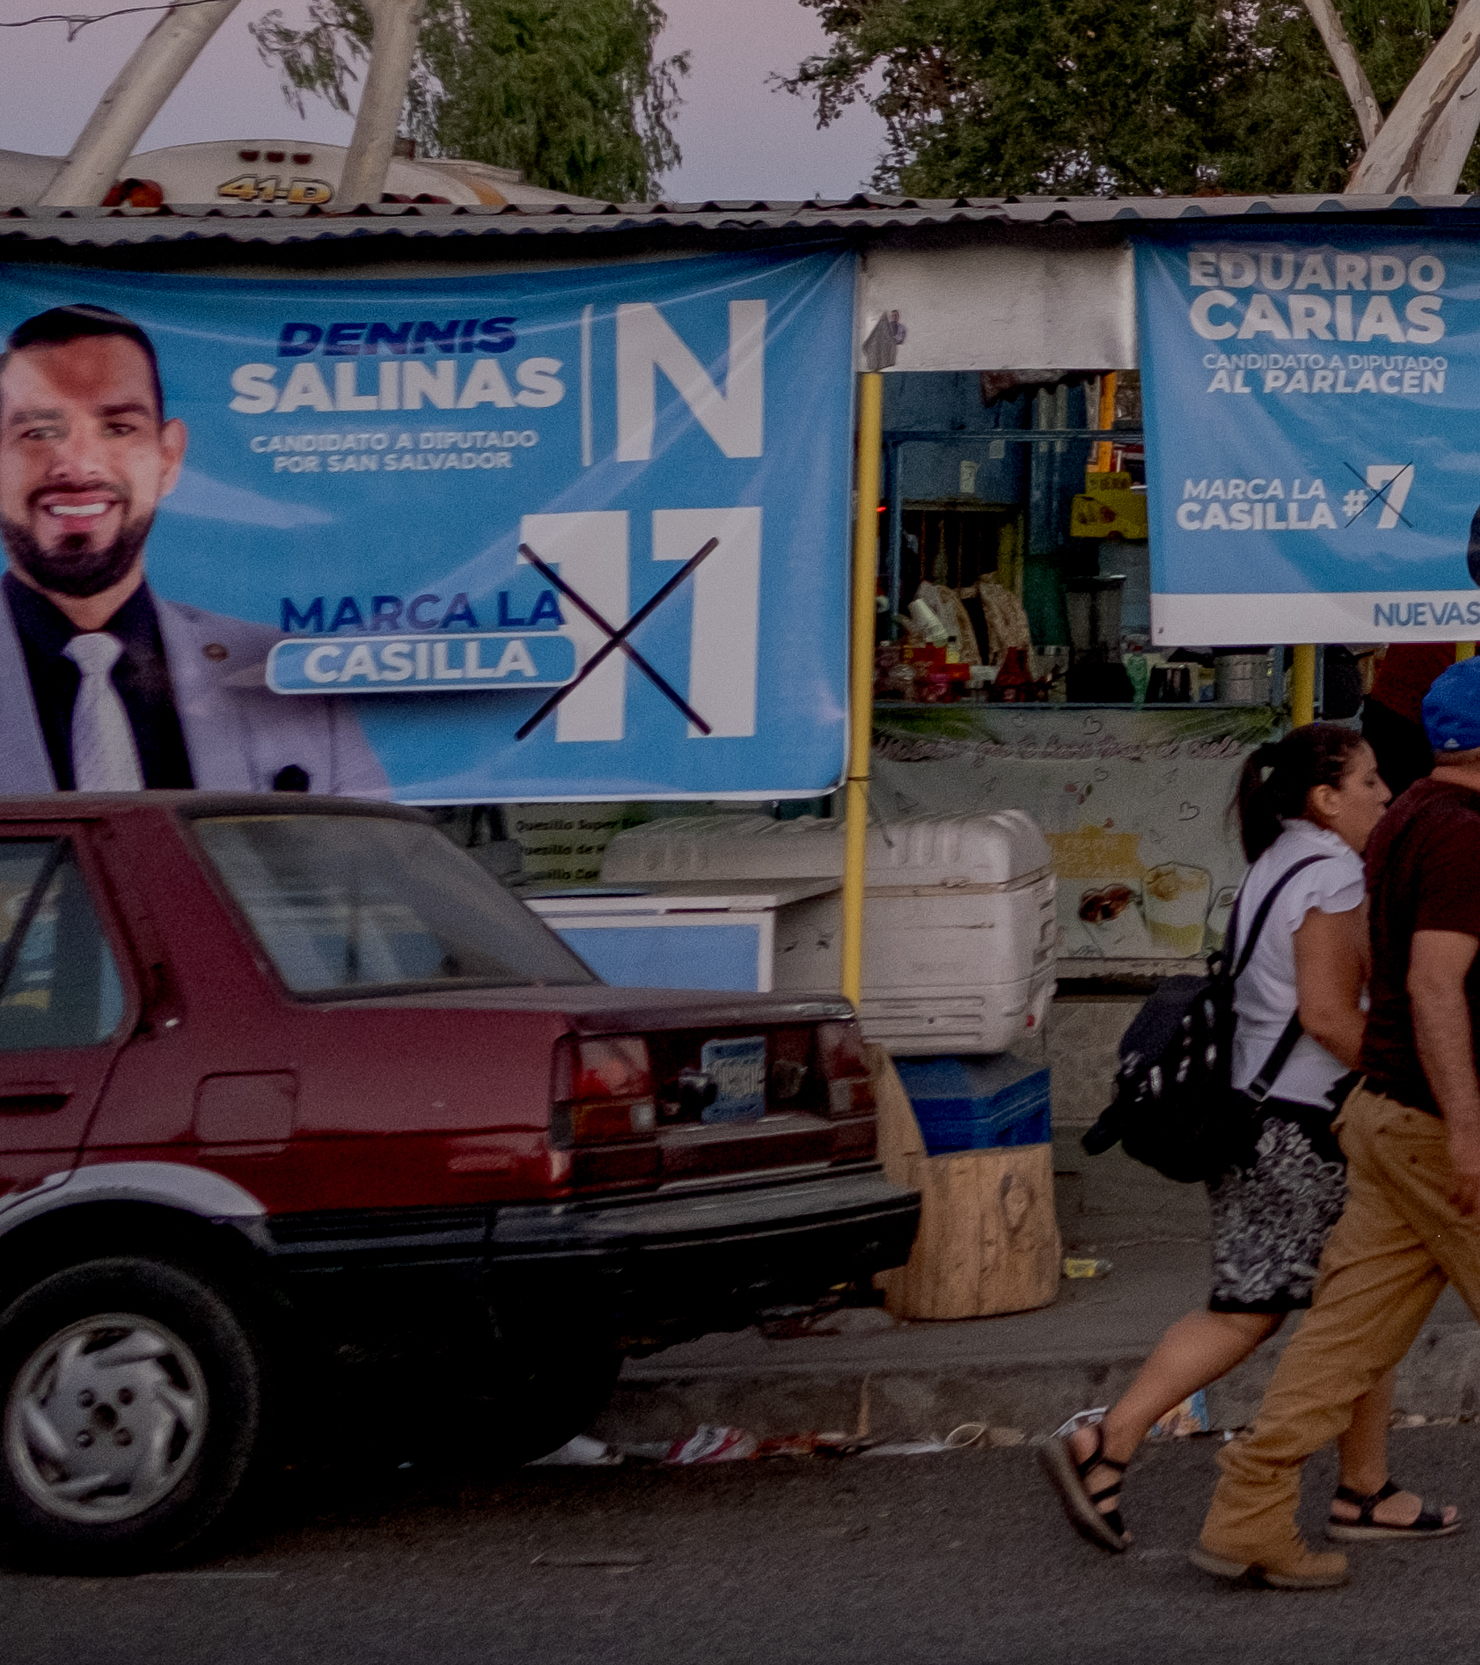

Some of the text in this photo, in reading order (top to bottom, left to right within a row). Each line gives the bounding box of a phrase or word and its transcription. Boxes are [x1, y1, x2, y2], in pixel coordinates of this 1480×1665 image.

[217, 173, 335, 205] 41-D
[1188, 251, 1446, 292] EDUARDO
[1189, 289, 1447, 345] CARIAS
[277, 316, 519, 358] DENNIS
[1203, 353, 1448, 371] CANDIDATO A DIPUTADO
[228, 357, 566, 415] SALINAS
[617, 299, 767, 463] N
[1206, 369, 1446, 394] AL PARLACEN
[249, 430, 539, 454] CANDIDATO A DIPUTADO
[273, 450, 512, 474] POR SAN SALVADOR
[1182, 478, 1326, 501] MARCA LA
[1176, 501, 1338, 531] CASILLA
[280, 589, 565, 635] MARCA LA
[516, 506, 763, 743] 11
[303, 640, 539, 685] CASILLA
[516, 820, 573, 834] Quesillo
[523, 844, 572, 855] uesillo
